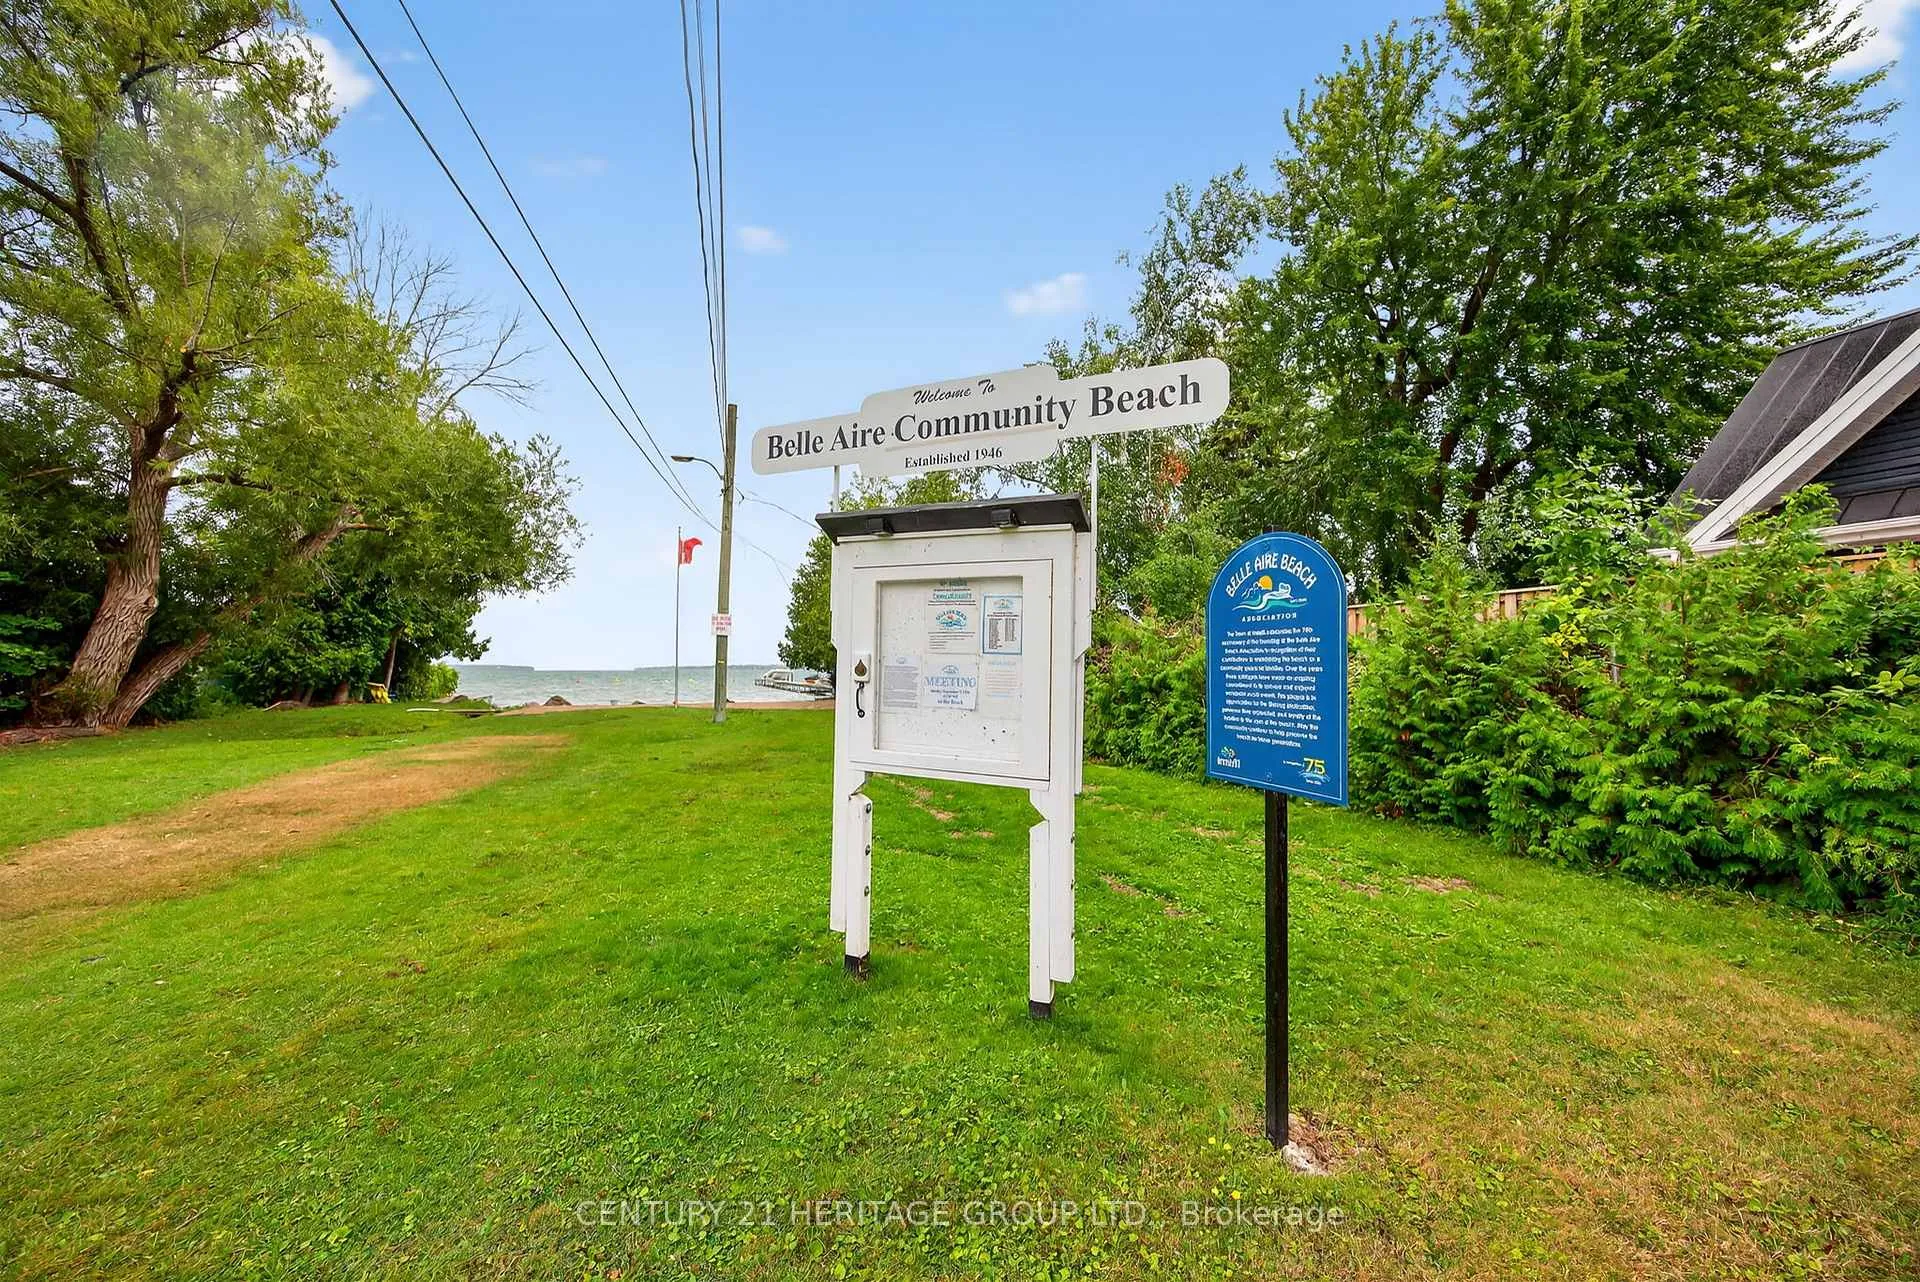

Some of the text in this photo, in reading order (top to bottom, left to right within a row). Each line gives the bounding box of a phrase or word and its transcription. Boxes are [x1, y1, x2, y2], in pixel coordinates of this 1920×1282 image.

[914, 379, 995, 405] Welcome To
[767, 373, 1201, 459] Belle Aire Community Beach
[904, 448, 1003, 469] Established 1946
[1225, 552, 1317, 598] BELLE AIRE BEACH
[1242, 612, 1297, 623] ASSOCIATION
[1303, 757, 1326, 775] 75
